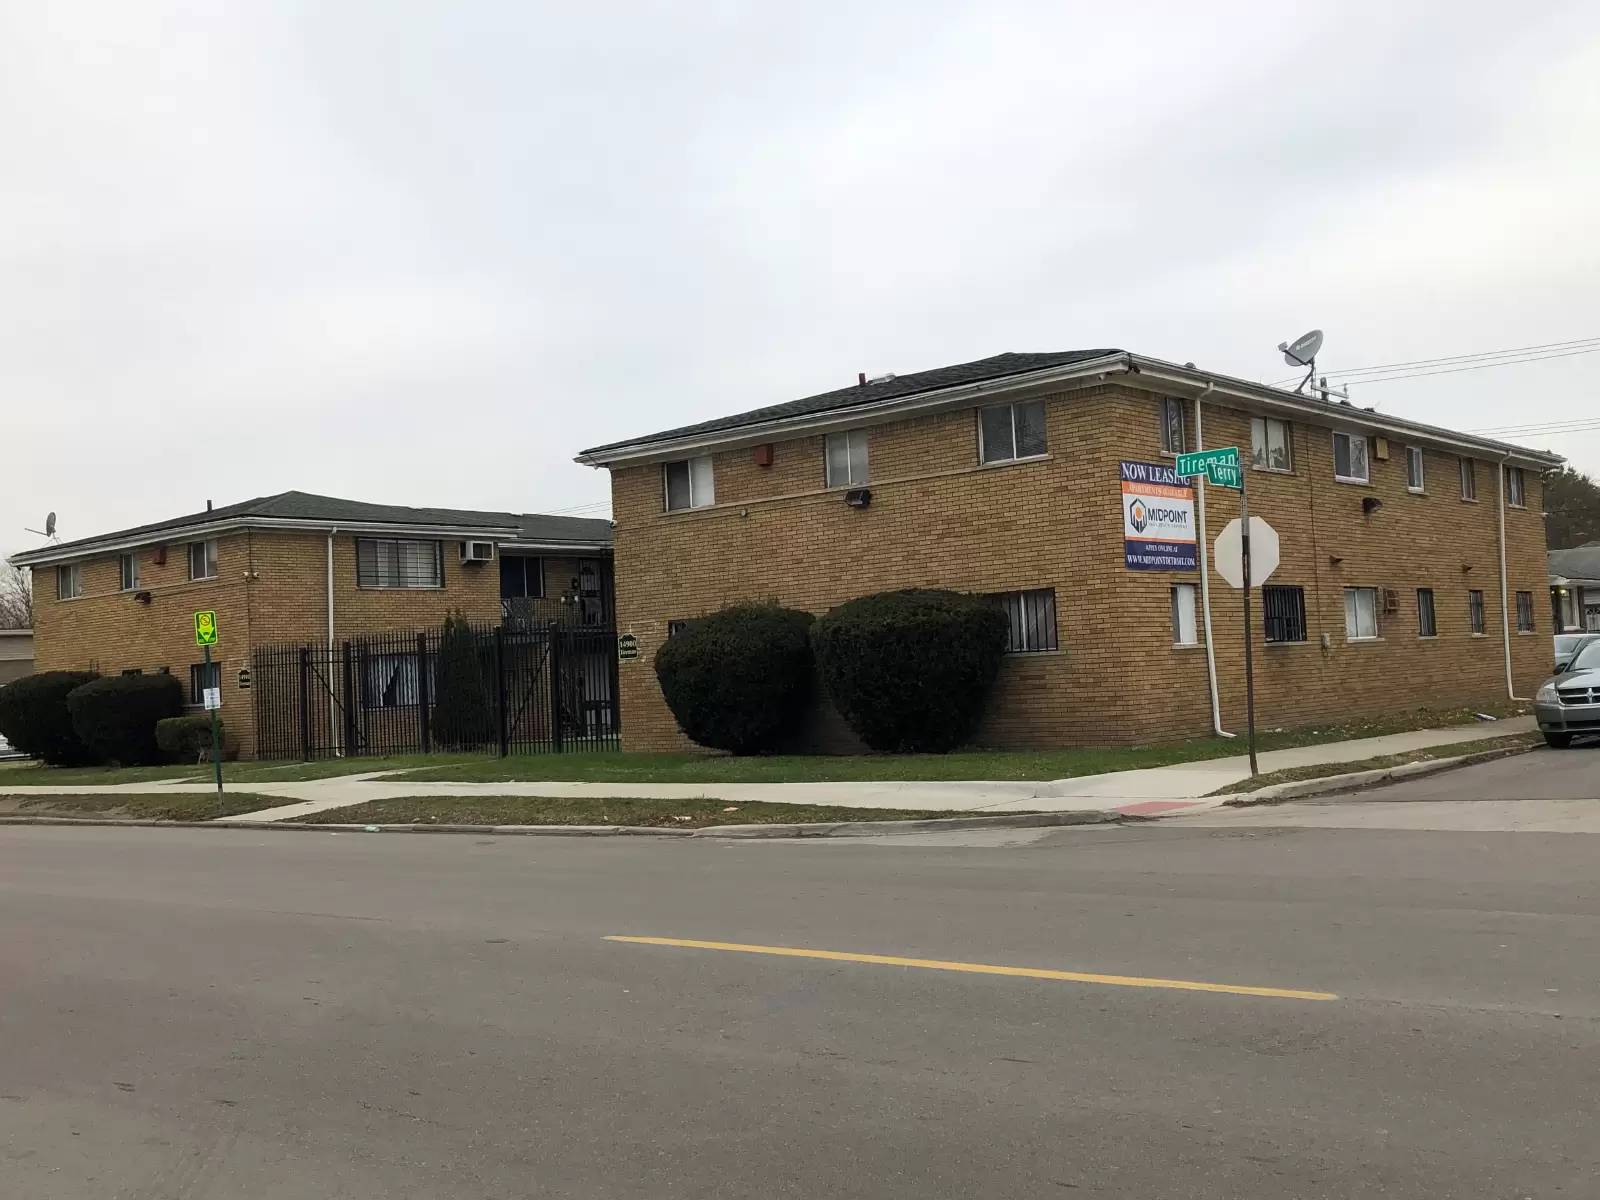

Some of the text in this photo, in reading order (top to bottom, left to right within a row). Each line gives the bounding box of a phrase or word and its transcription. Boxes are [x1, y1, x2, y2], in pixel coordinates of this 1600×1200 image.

[1180, 454, 1234, 473] Tireman
[1121, 463, 1190, 485] NOW LEASING
[1212, 464, 1236, 485] Terry
[1148, 508, 1187, 523] MIDPOINT
